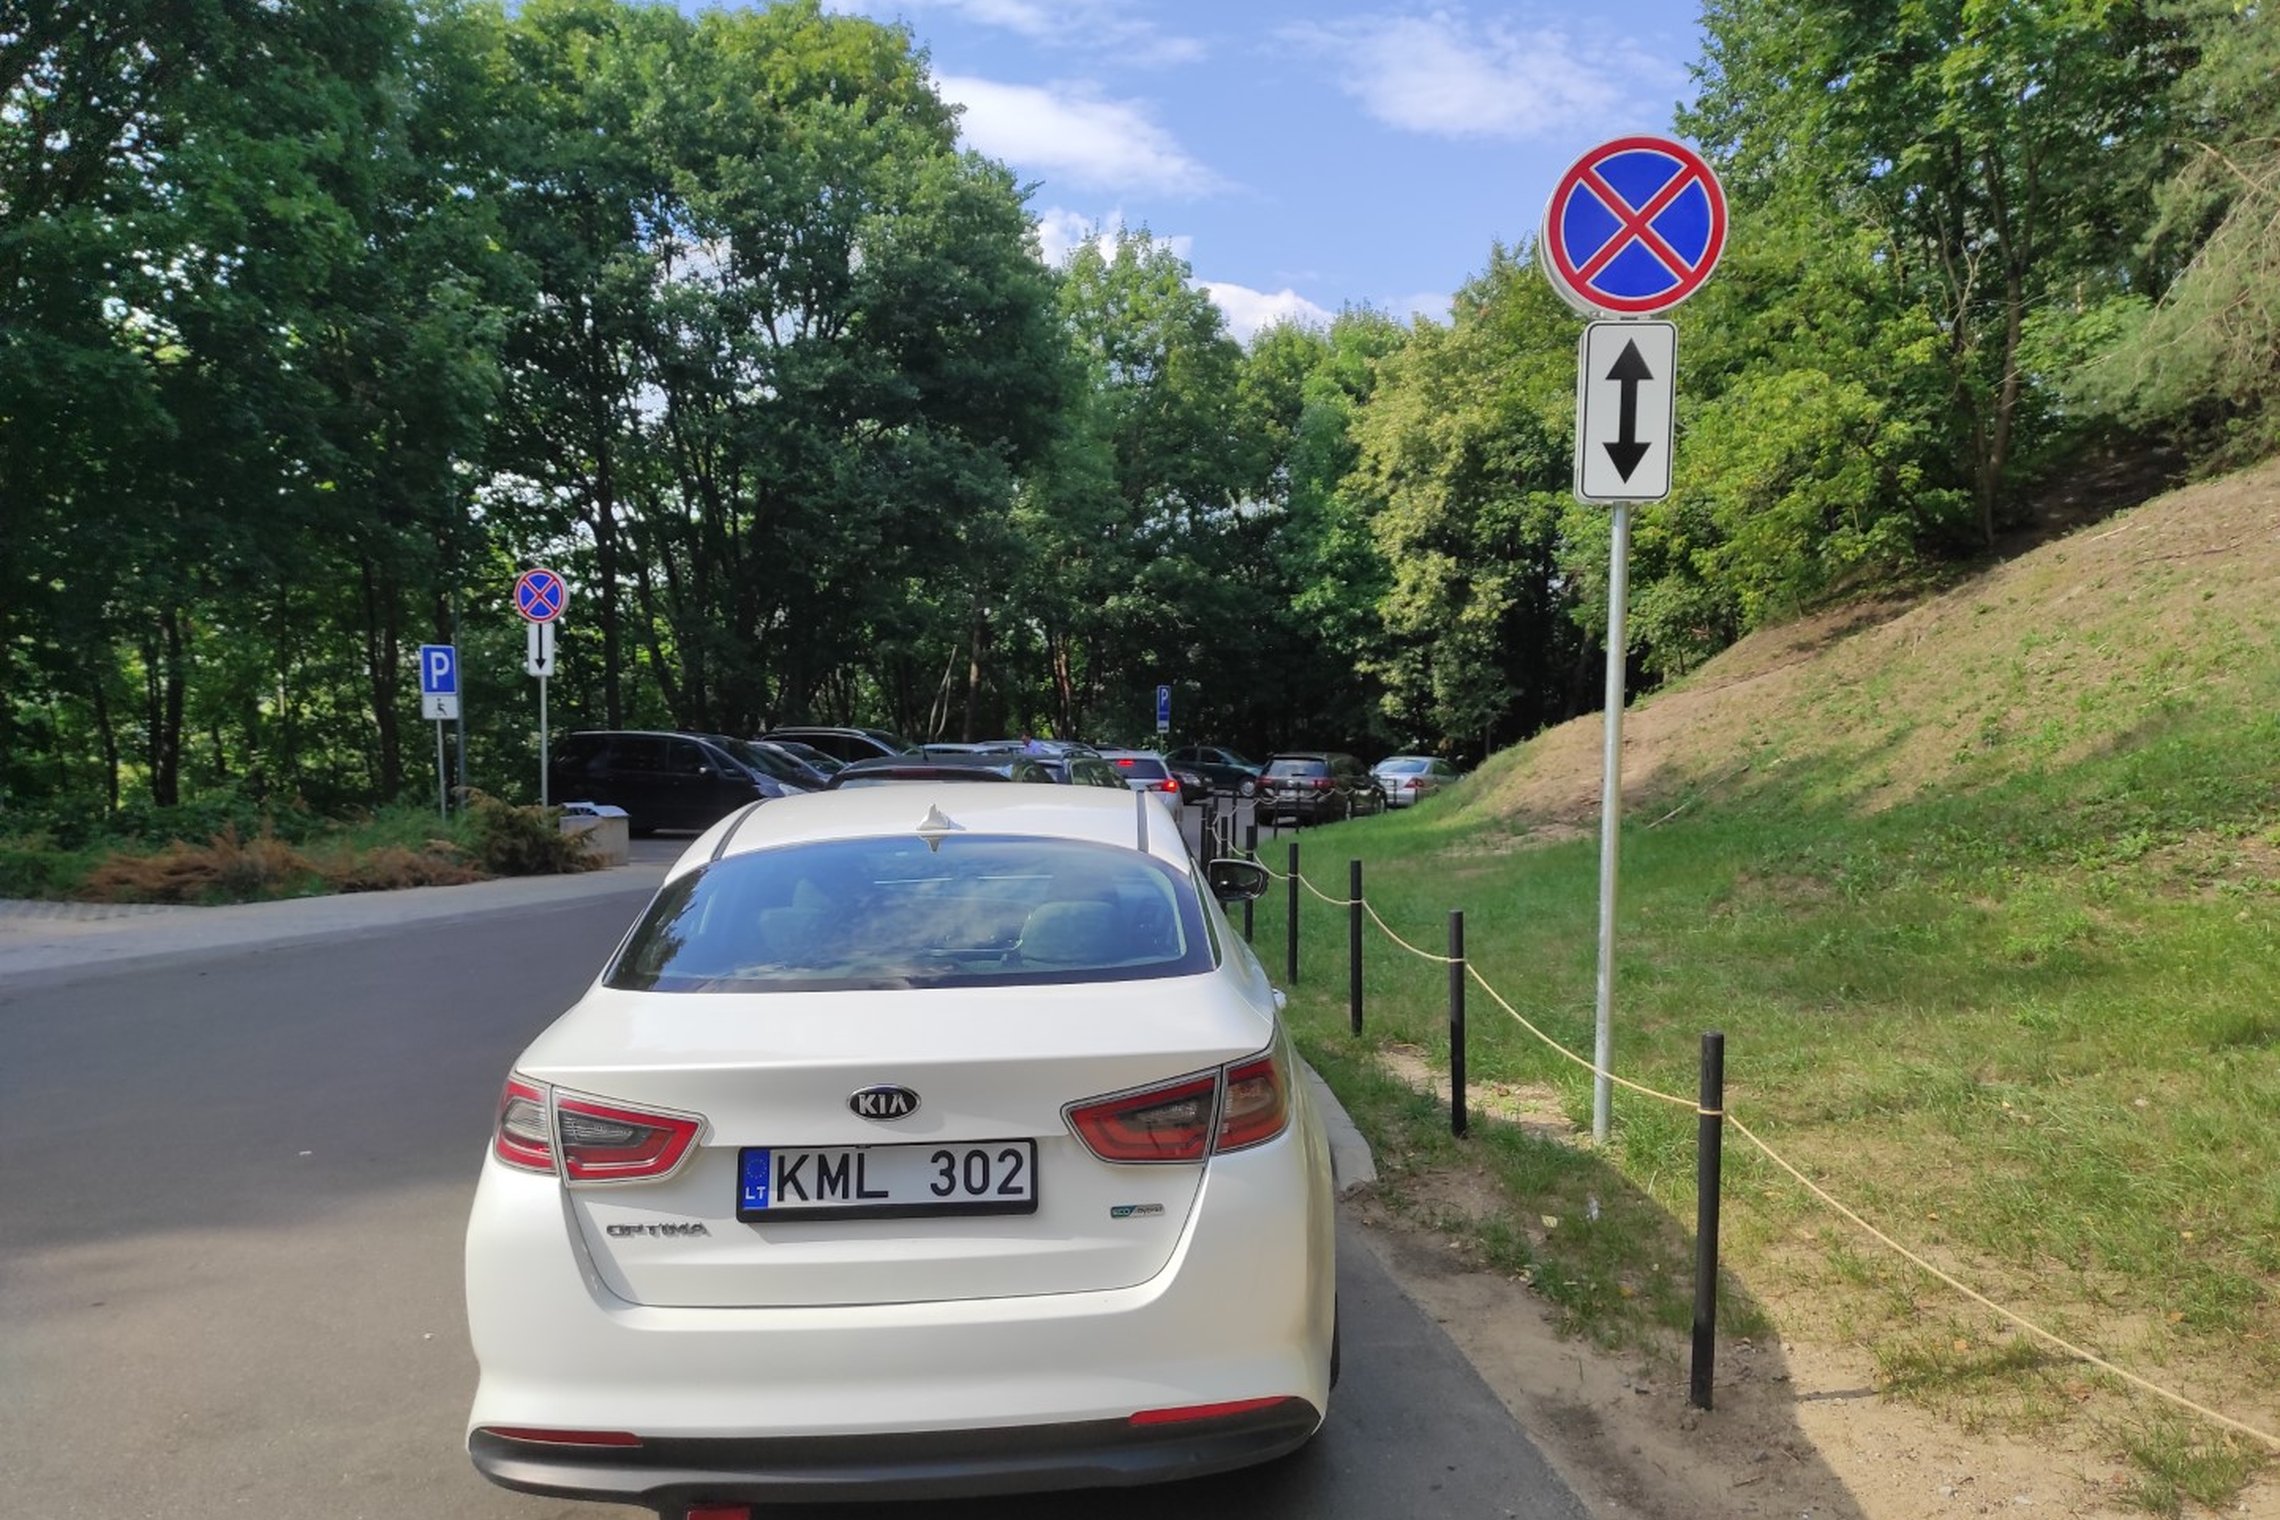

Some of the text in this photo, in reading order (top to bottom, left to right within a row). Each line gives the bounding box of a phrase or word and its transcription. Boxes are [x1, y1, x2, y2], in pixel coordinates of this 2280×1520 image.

[430, 652, 450, 689] P
[1161, 688, 1169, 707] P
[858, 1094, 908, 1114] KIA
[777, 1148, 1024, 1201] KML 302
[745, 1185, 766, 1200] LT
[607, 1222, 709, 1236] OPTIMA
